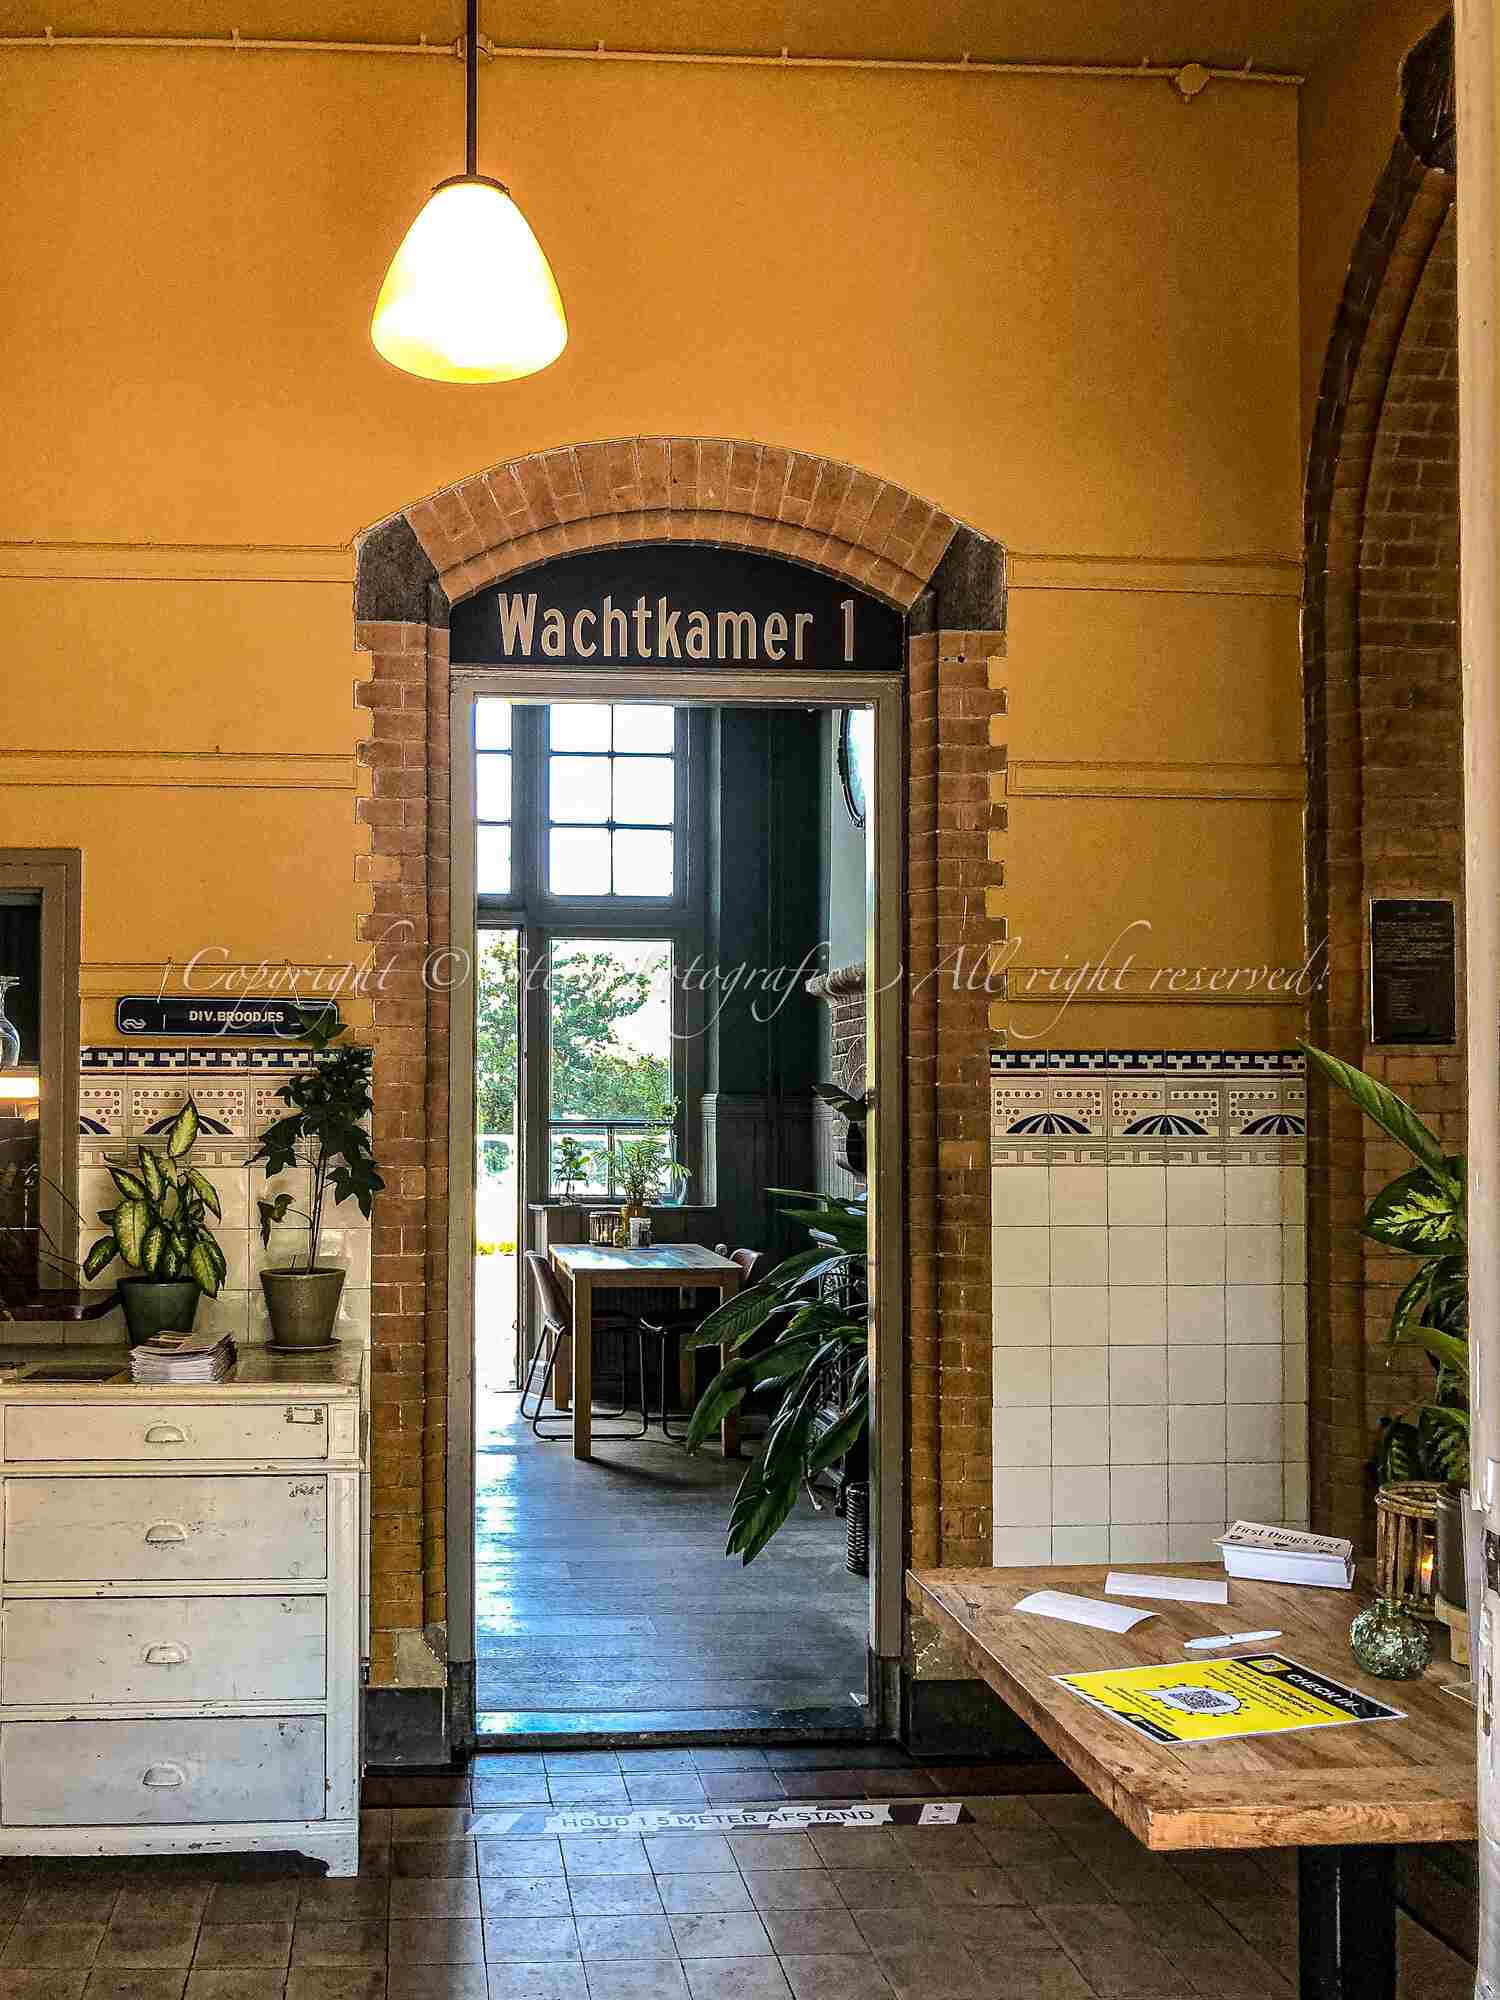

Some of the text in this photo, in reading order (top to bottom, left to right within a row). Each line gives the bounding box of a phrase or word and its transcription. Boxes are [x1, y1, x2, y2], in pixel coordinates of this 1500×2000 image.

[498, 593, 854, 661] Wachtkamer 1
[1234, 1525, 1342, 1549] First things first
[1286, 1674, 1343, 1698] CHECK
[561, 1816, 629, 1827] HOUD
[676, 1813, 757, 1825] METER
[767, 1810, 875, 1823] AFSTAND
